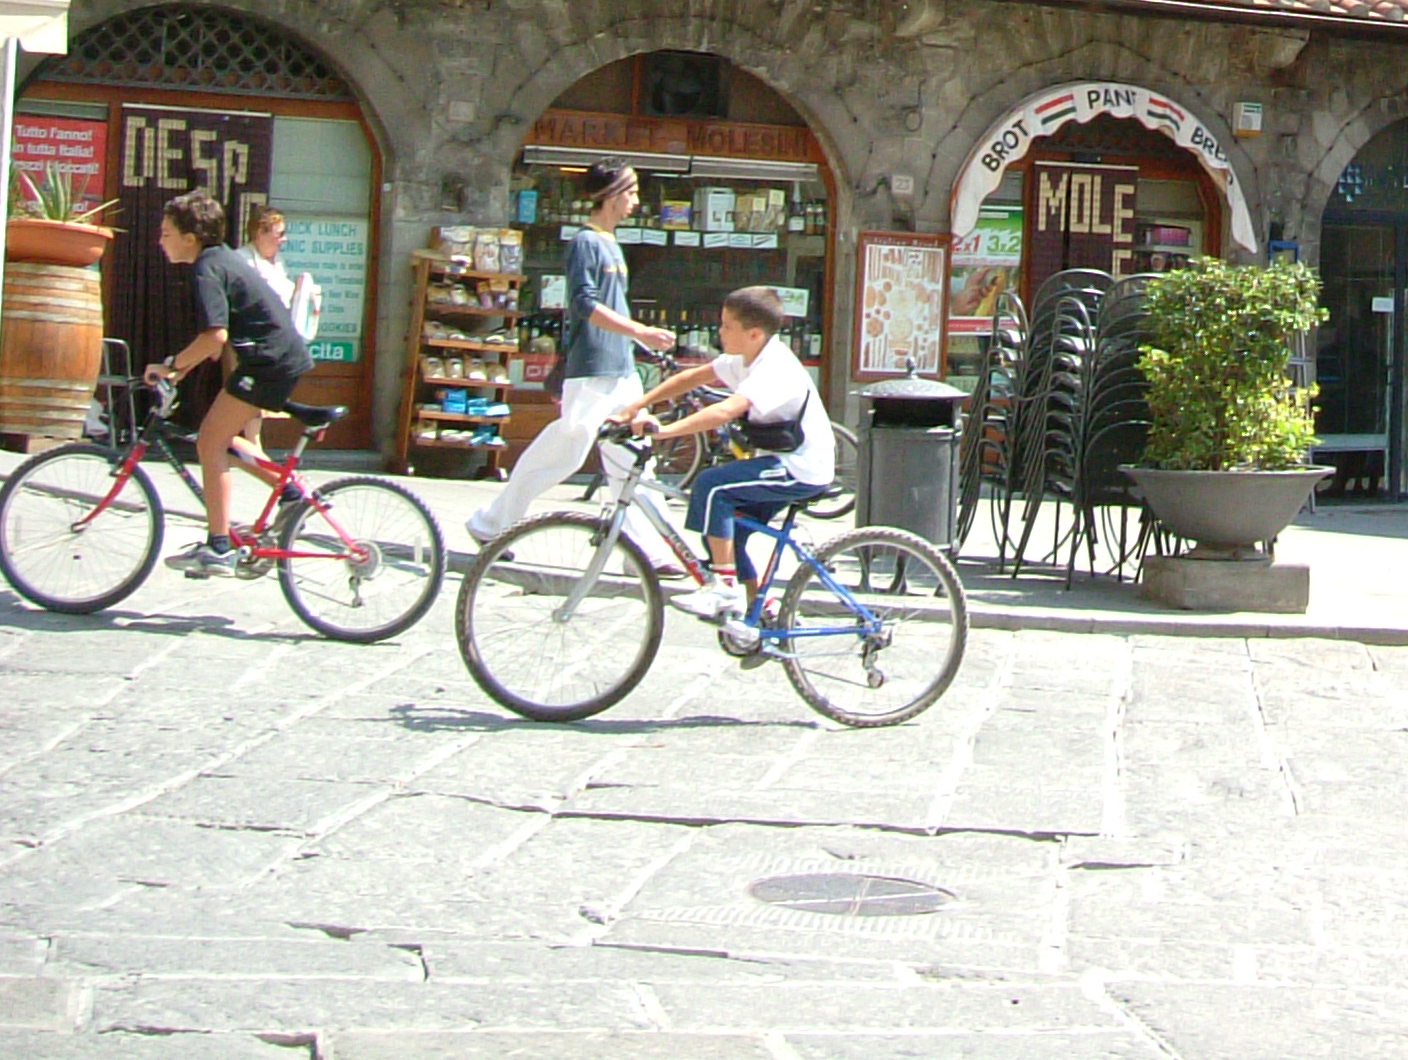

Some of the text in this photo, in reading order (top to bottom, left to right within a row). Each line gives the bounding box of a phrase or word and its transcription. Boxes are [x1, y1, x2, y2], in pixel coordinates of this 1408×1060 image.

[981, 119, 1029, 173] BROT
[1087, 88, 1136, 109] PAN
[318, 223, 357, 237] LUNCH
[311, 240, 364, 256] SUPPLIES
[318, 321, 358, 334] OOKIES
[308, 342, 344, 360] cita
